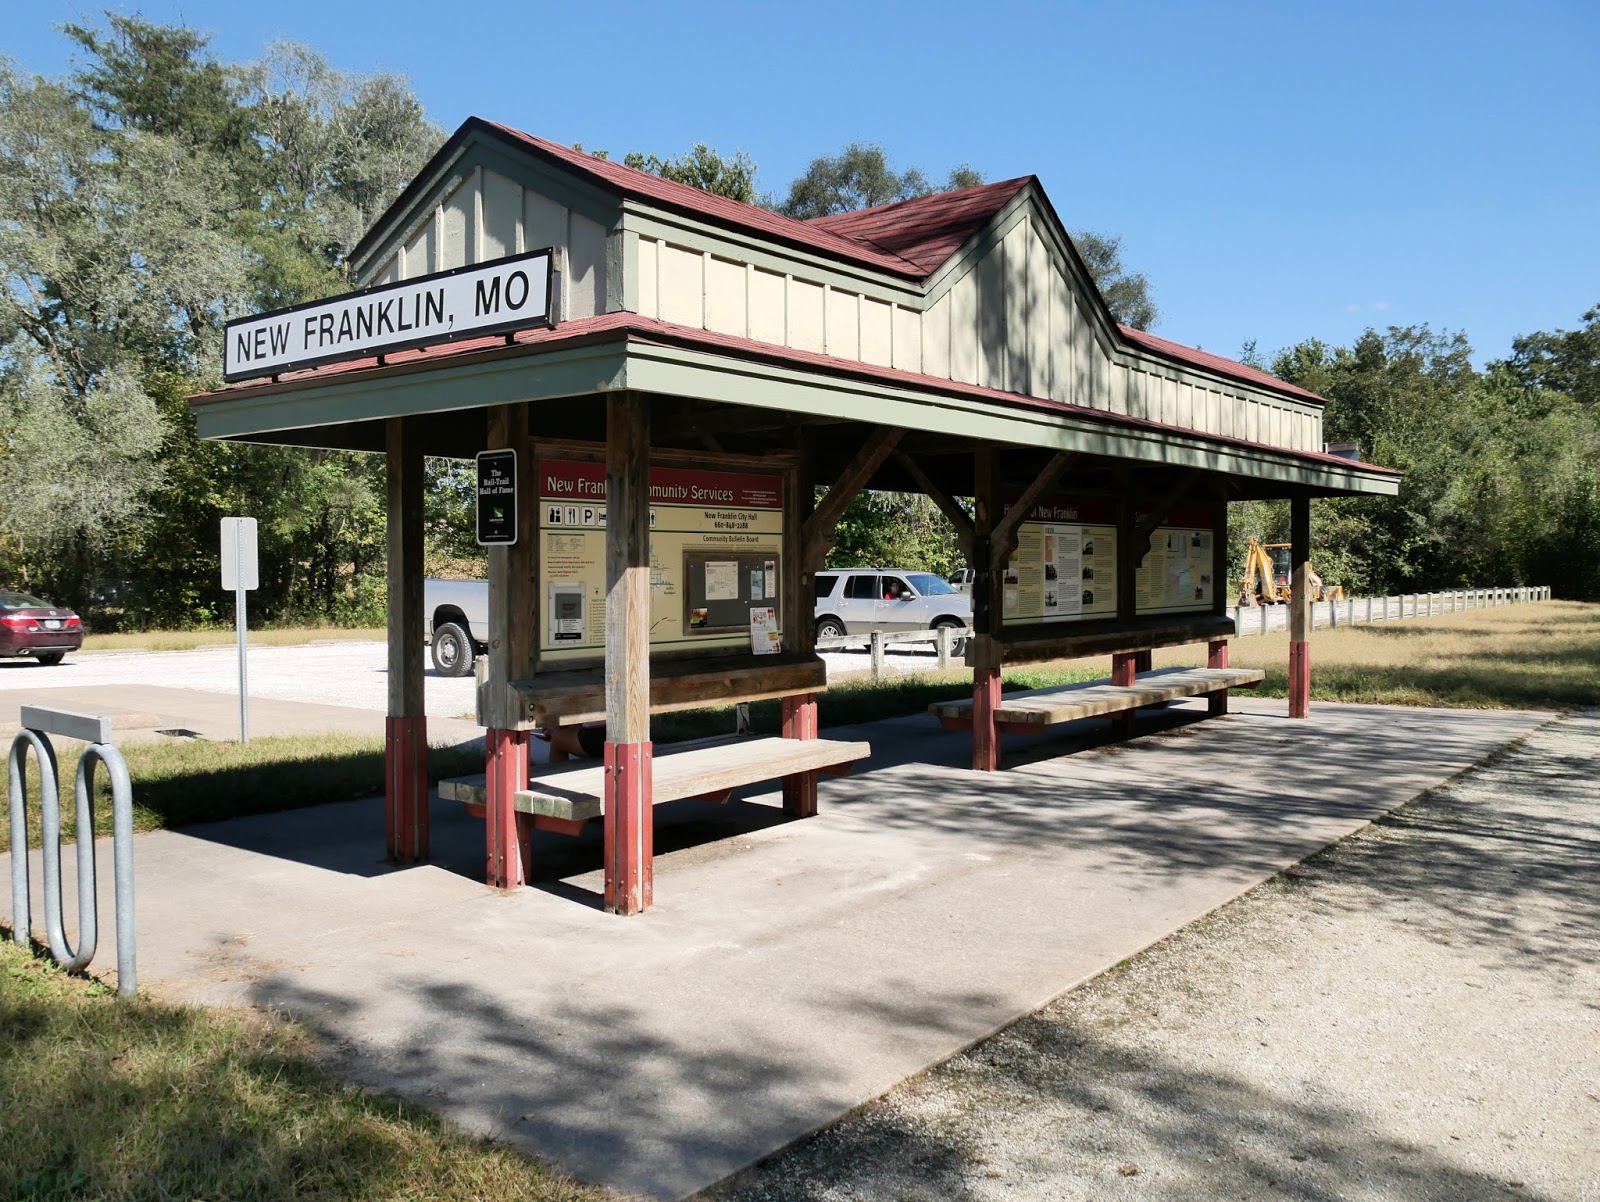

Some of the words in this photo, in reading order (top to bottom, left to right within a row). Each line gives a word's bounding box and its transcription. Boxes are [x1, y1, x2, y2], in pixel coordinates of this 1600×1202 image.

[237, 321, 291, 364] NEW
[304, 288, 454, 350] FRANKLIN,
[474, 270, 530, 317] MO
[491, 469, 502, 477] The
[483, 477, 510, 486] Rail-Trail
[479, 487, 491, 495] Hall
[547, 476, 574, 493] New
[577, 478, 607, 494] Fran
[649, 484, 688, 499] munity
[691, 485, 734, 501] Services
[704, 512, 716, 520] New
[717, 512, 738, 520] Franklin
[738, 512, 747, 521] City
[1038, 506, 1052, 518] New
[703, 535, 728, 543] Community
[728, 535, 745, 543] Bulletin
